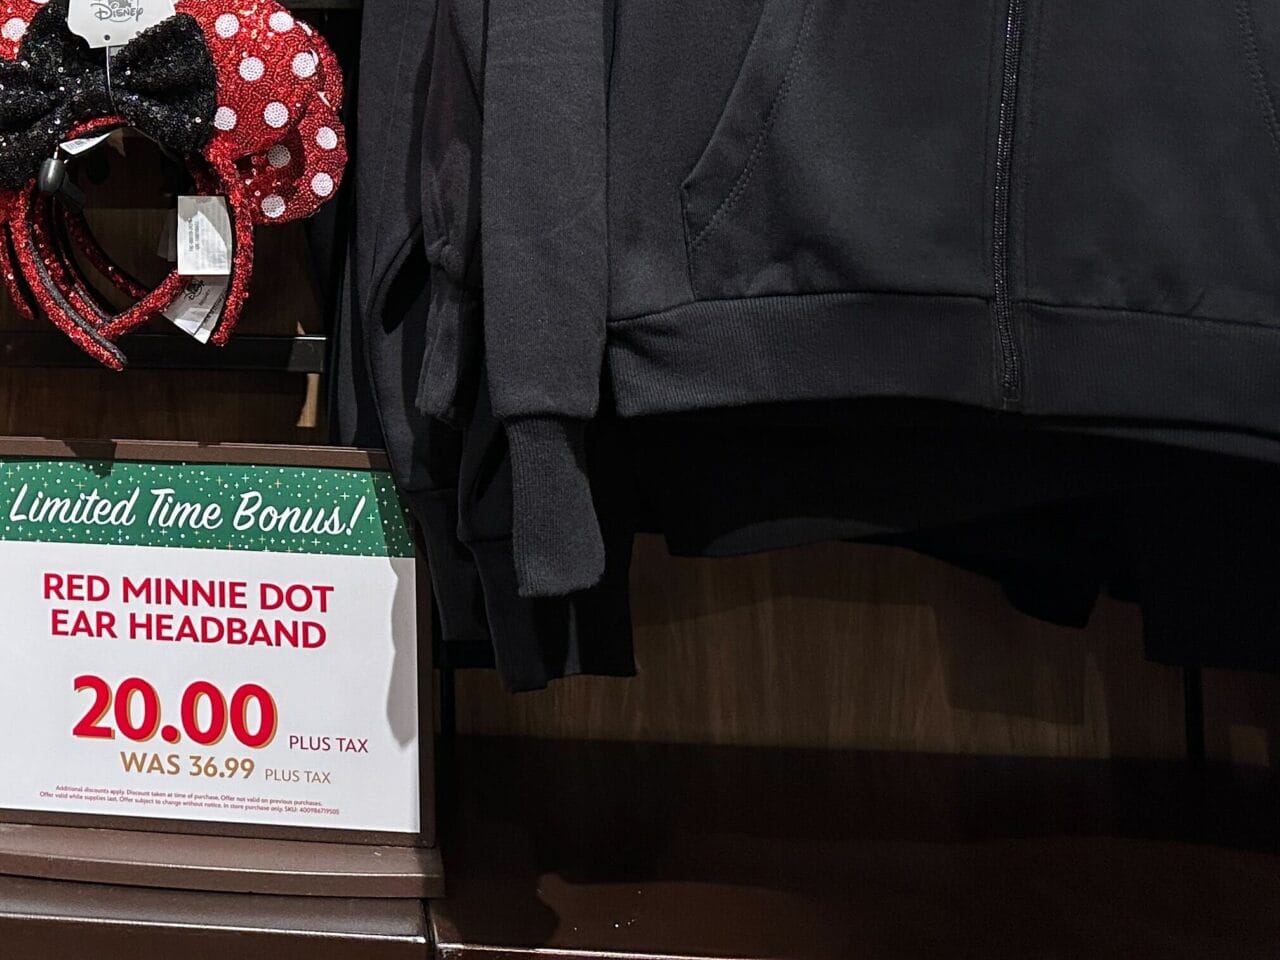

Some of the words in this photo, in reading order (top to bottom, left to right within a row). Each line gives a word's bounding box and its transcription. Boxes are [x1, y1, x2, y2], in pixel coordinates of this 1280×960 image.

[90, 2, 144, 23] Disney
[9, 484, 141, 527] Limited
[146, 488, 222, 531] Time
[233, 490, 366, 536] Bonus!
[42, 573, 111, 603] RED
[122, 577, 248, 609] MINNIE
[259, 583, 335, 613] DOT
[50, 609, 117, 639] EAR
[128, 612, 327, 649] HEADBAND
[72, 675, 278, 749] 20.00
[289, 735, 331, 753] PLUS
[335, 737, 369, 754] TAX
[120, 751, 180, 776] WAS
[189, 755, 255, 780] 36.99
[265, 768, 300, 783] PLUS
[304, 770, 332, 785] TAX
